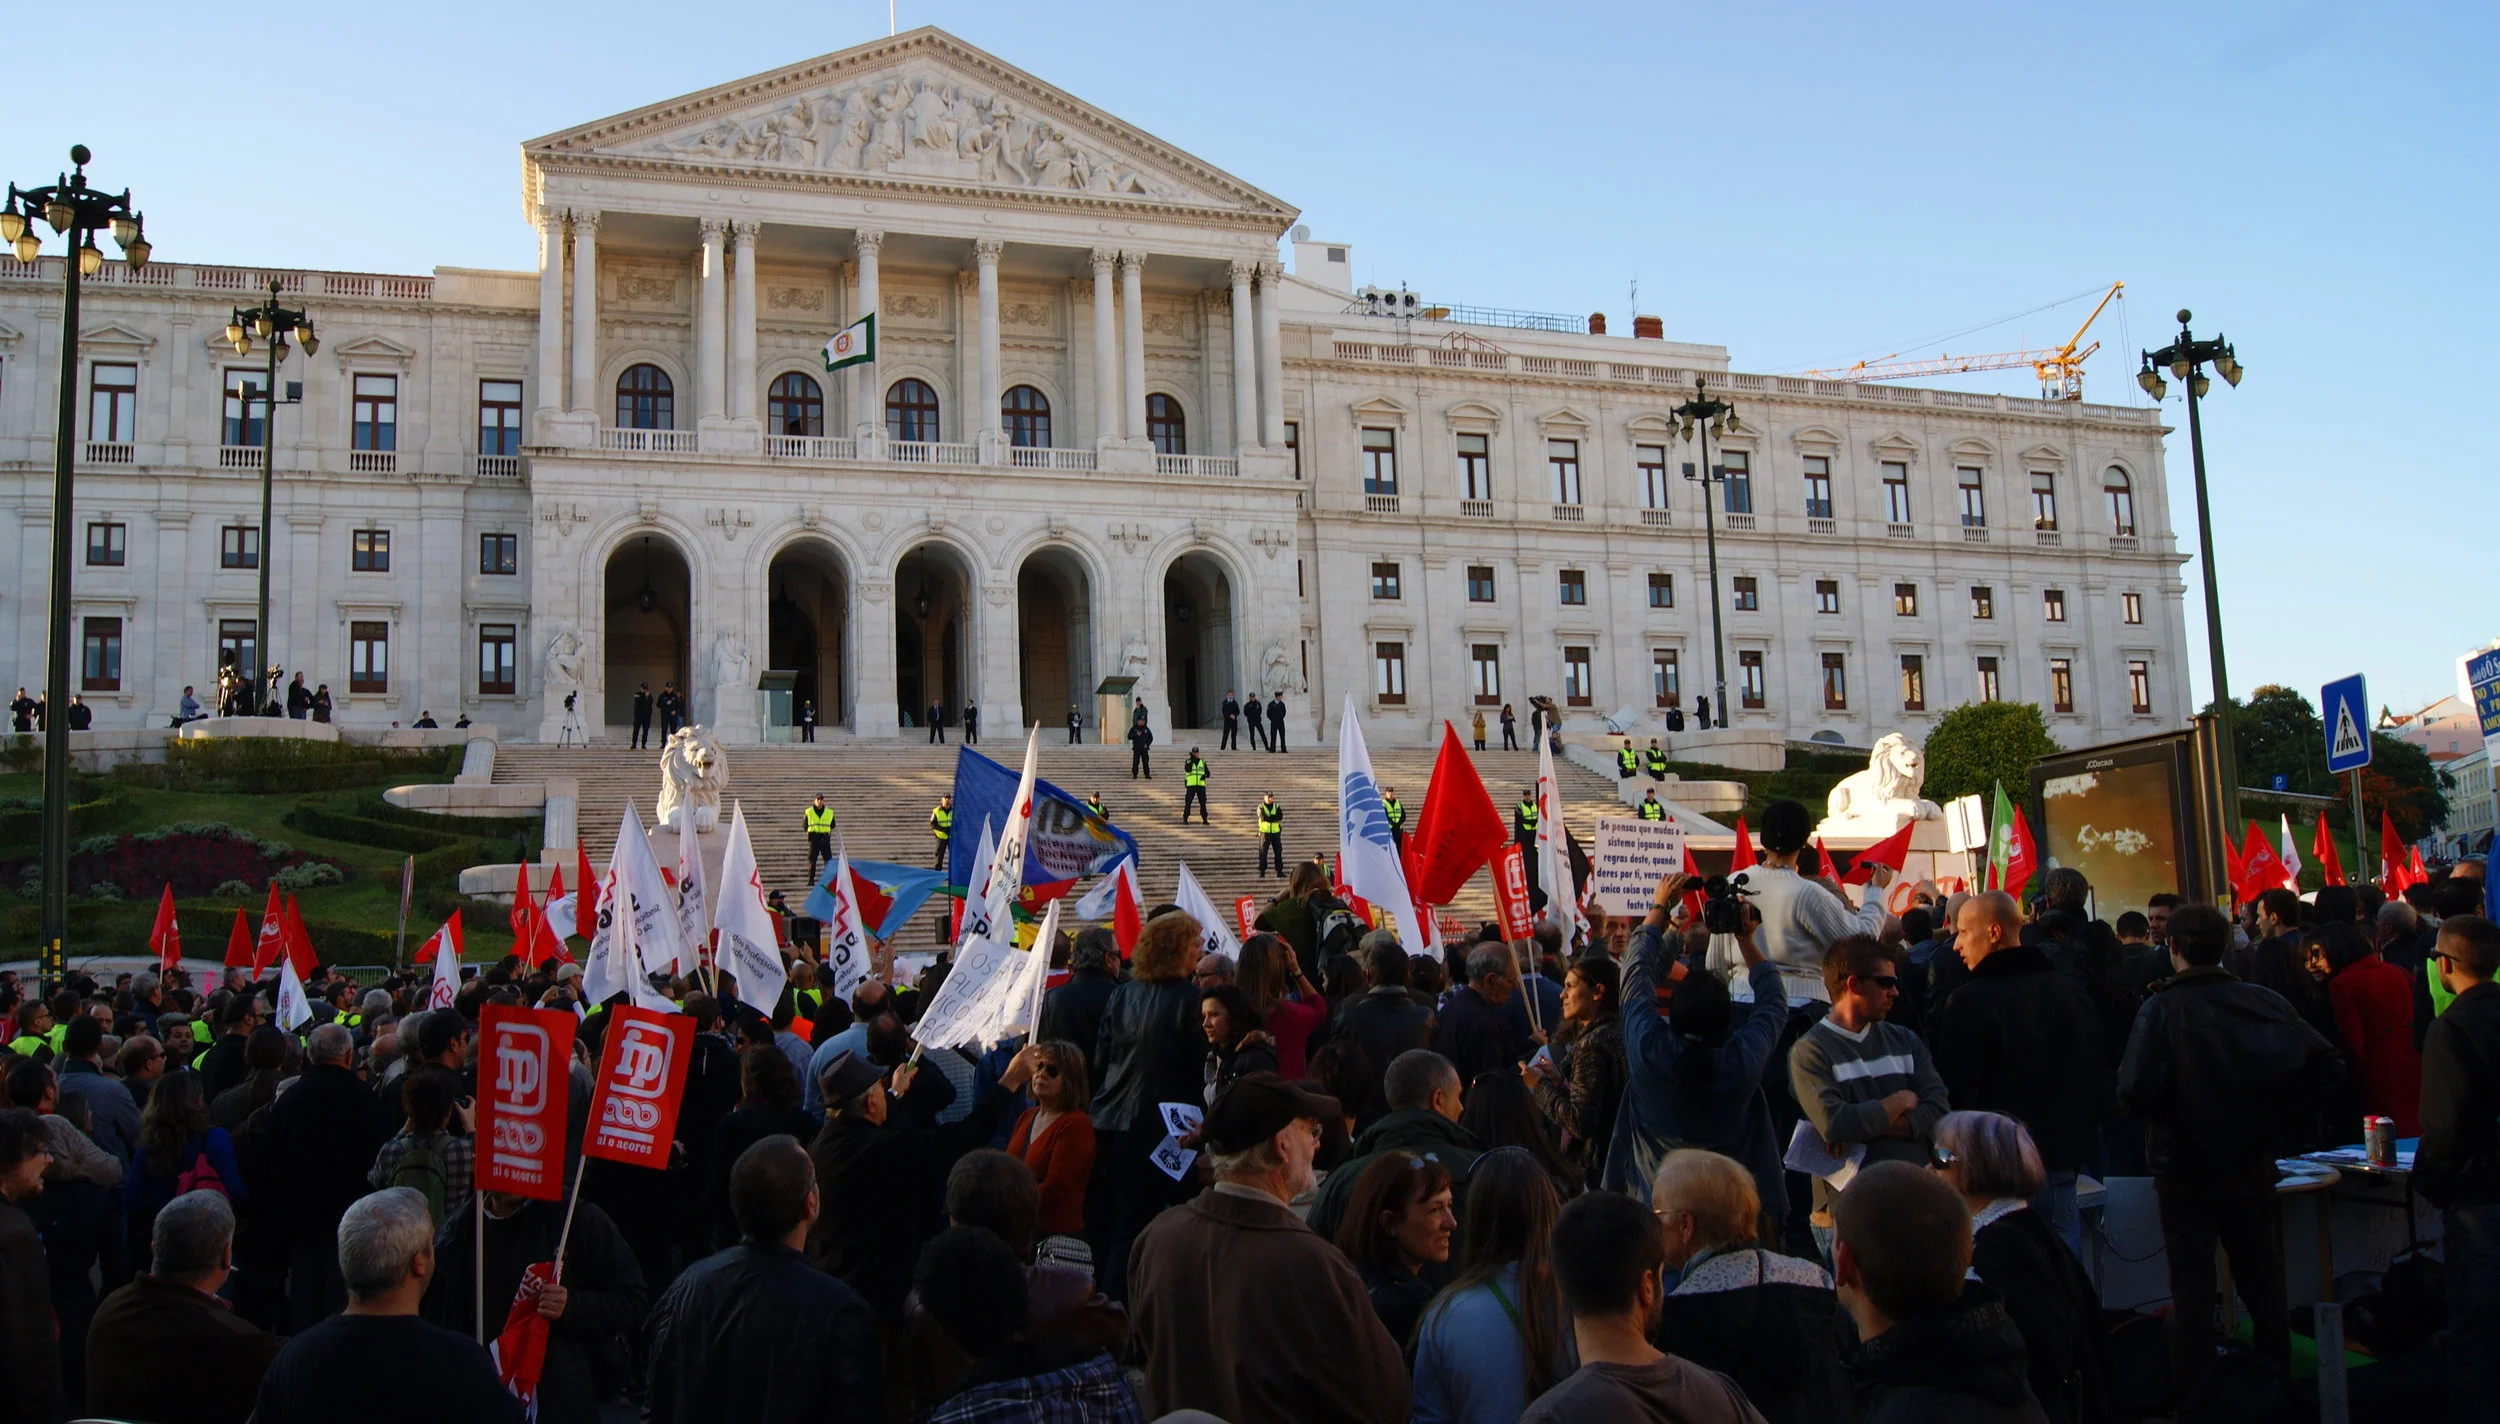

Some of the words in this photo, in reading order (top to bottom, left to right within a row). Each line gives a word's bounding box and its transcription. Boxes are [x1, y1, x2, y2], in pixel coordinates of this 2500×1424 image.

[2475, 687, 2487, 700] NO
[2480, 704, 2486, 716] A
[2276, 776, 2283, 786] P
[1600, 820, 1610, 830] Se
[1612, 823, 1637, 833] pensas
[1639, 825, 1651, 835] que
[1653, 824, 1674, 835] mudas
[1608, 836, 1635, 847] sistema
[1637, 837, 1664, 851] jogando
[1604, 854, 1628, 865] regras
[1630, 853, 1651, 865] deste,
[1652, 856, 1676, 867] quando
[1597, 867, 1618, 878] deres
[1620, 870, 1632, 880] por
[1600, 883, 1621, 894] única
[1623, 884, 1640, 894] coisa
[1642, 886, 1655, 896] que
[1627, 899, 1644, 910] foste
[732, 934, 744, 948] dos
[745, 944, 782, 978] Professores
[743, 957, 764, 980] Lisboa
[616, 1140, 653, 1154] açores
